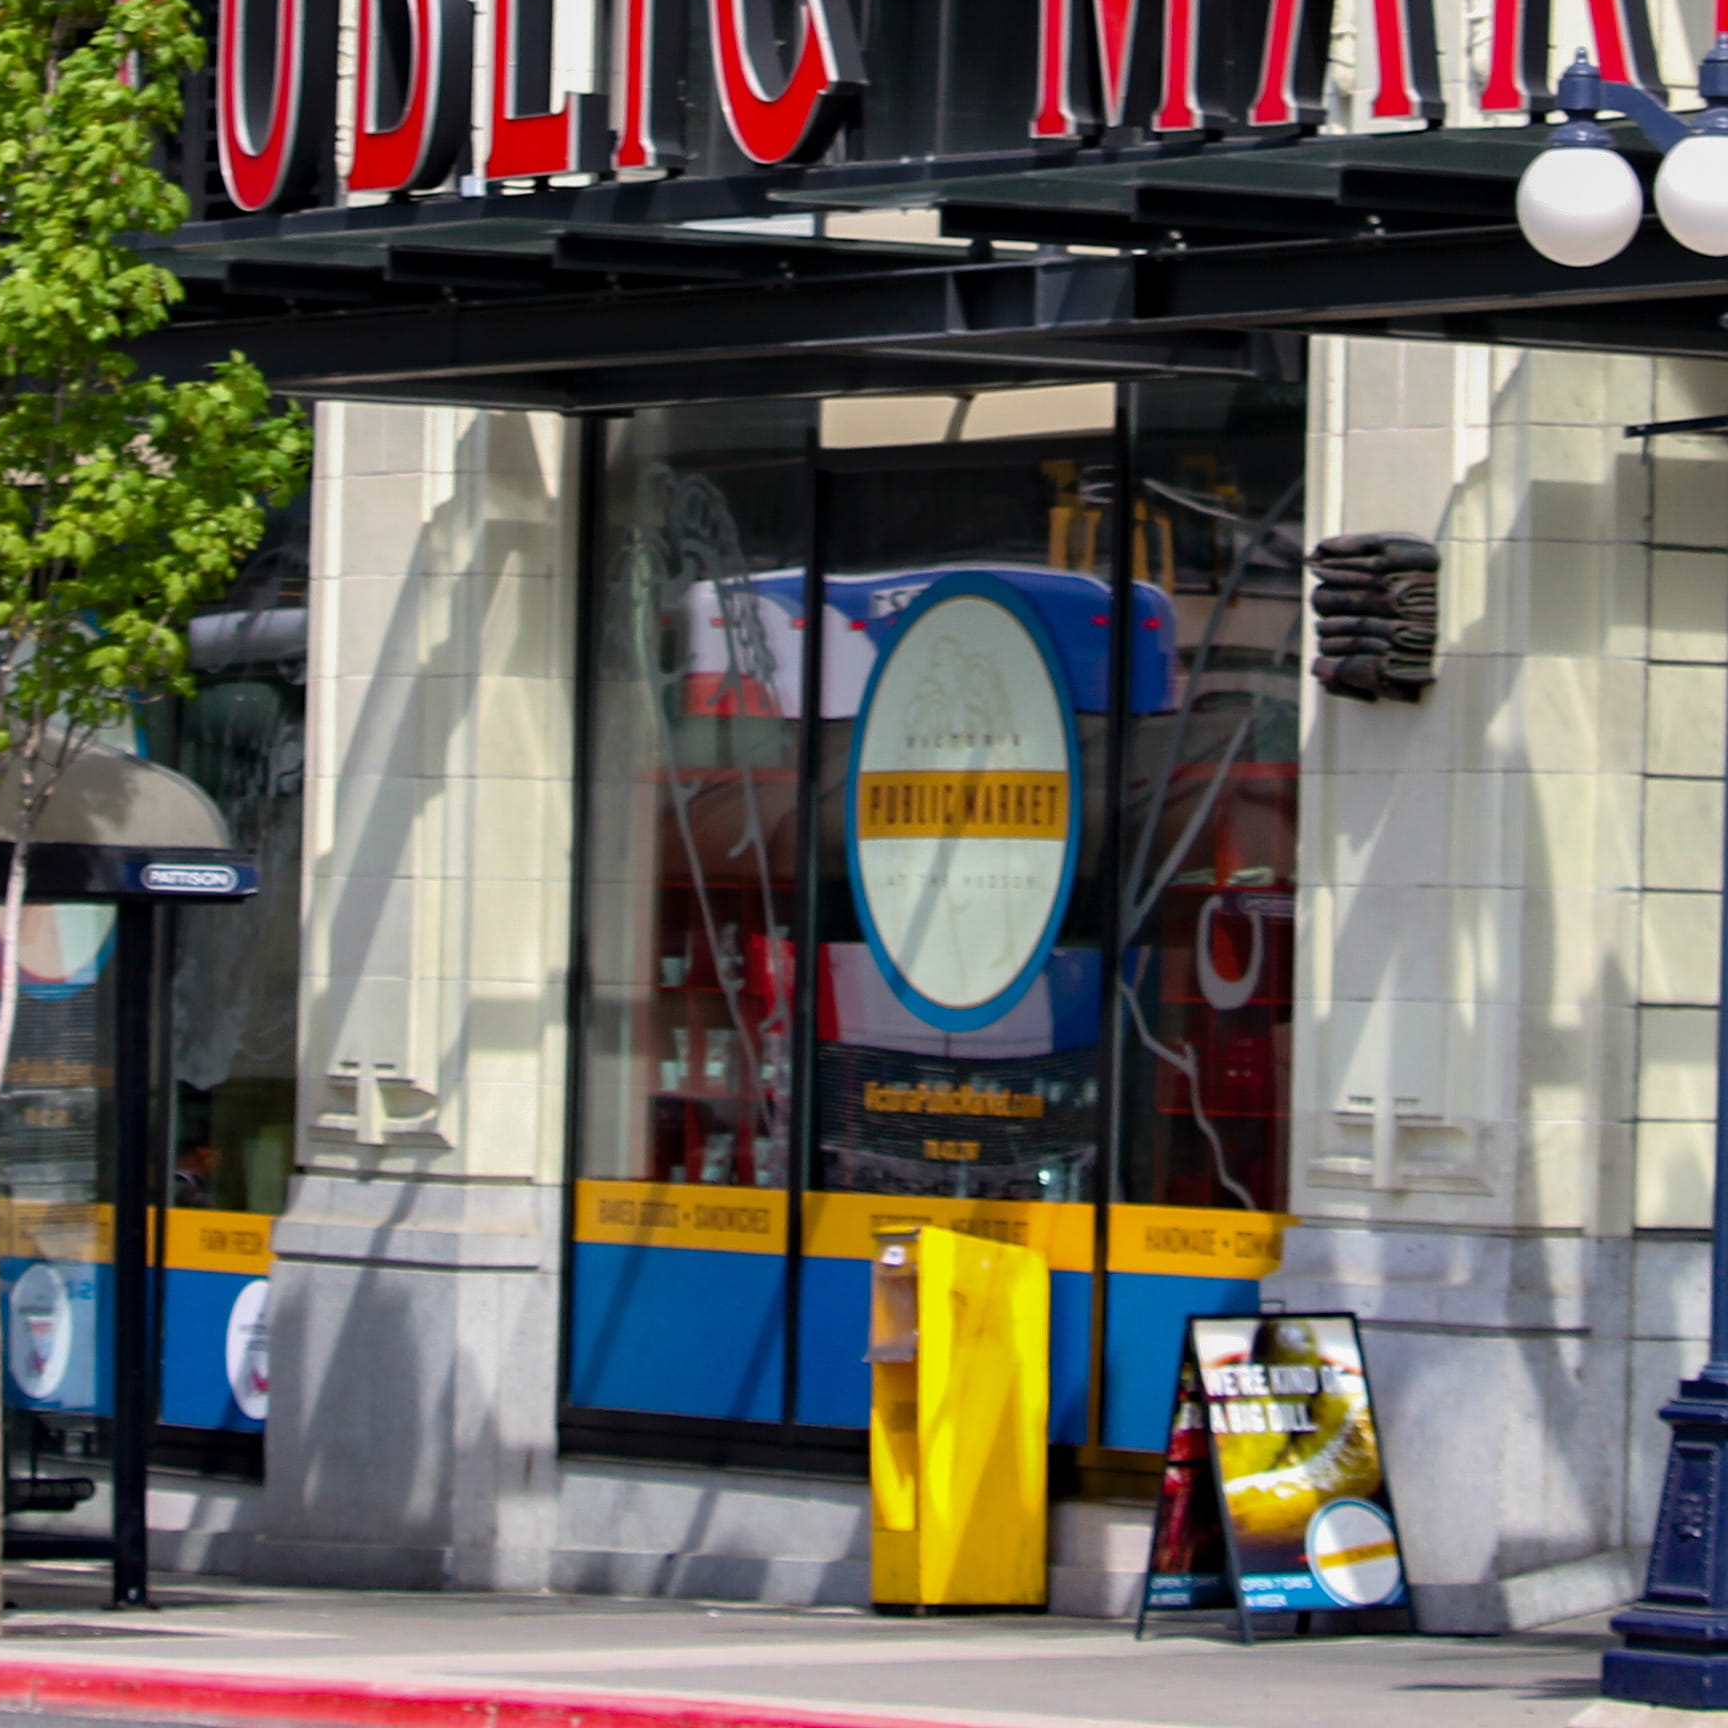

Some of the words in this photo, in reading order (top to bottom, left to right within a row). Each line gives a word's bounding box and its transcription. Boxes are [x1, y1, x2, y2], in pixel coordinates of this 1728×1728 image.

[870, 784, 955, 825] PUBLIC
[962, 783, 1060, 827] MARKET
[149, 871, 229, 886] PATTISON
[1206, 1364, 1270, 1396] WE'RE
[1209, 1402, 1229, 1433] A
[1239, 1577, 1272, 1591] OPEN
